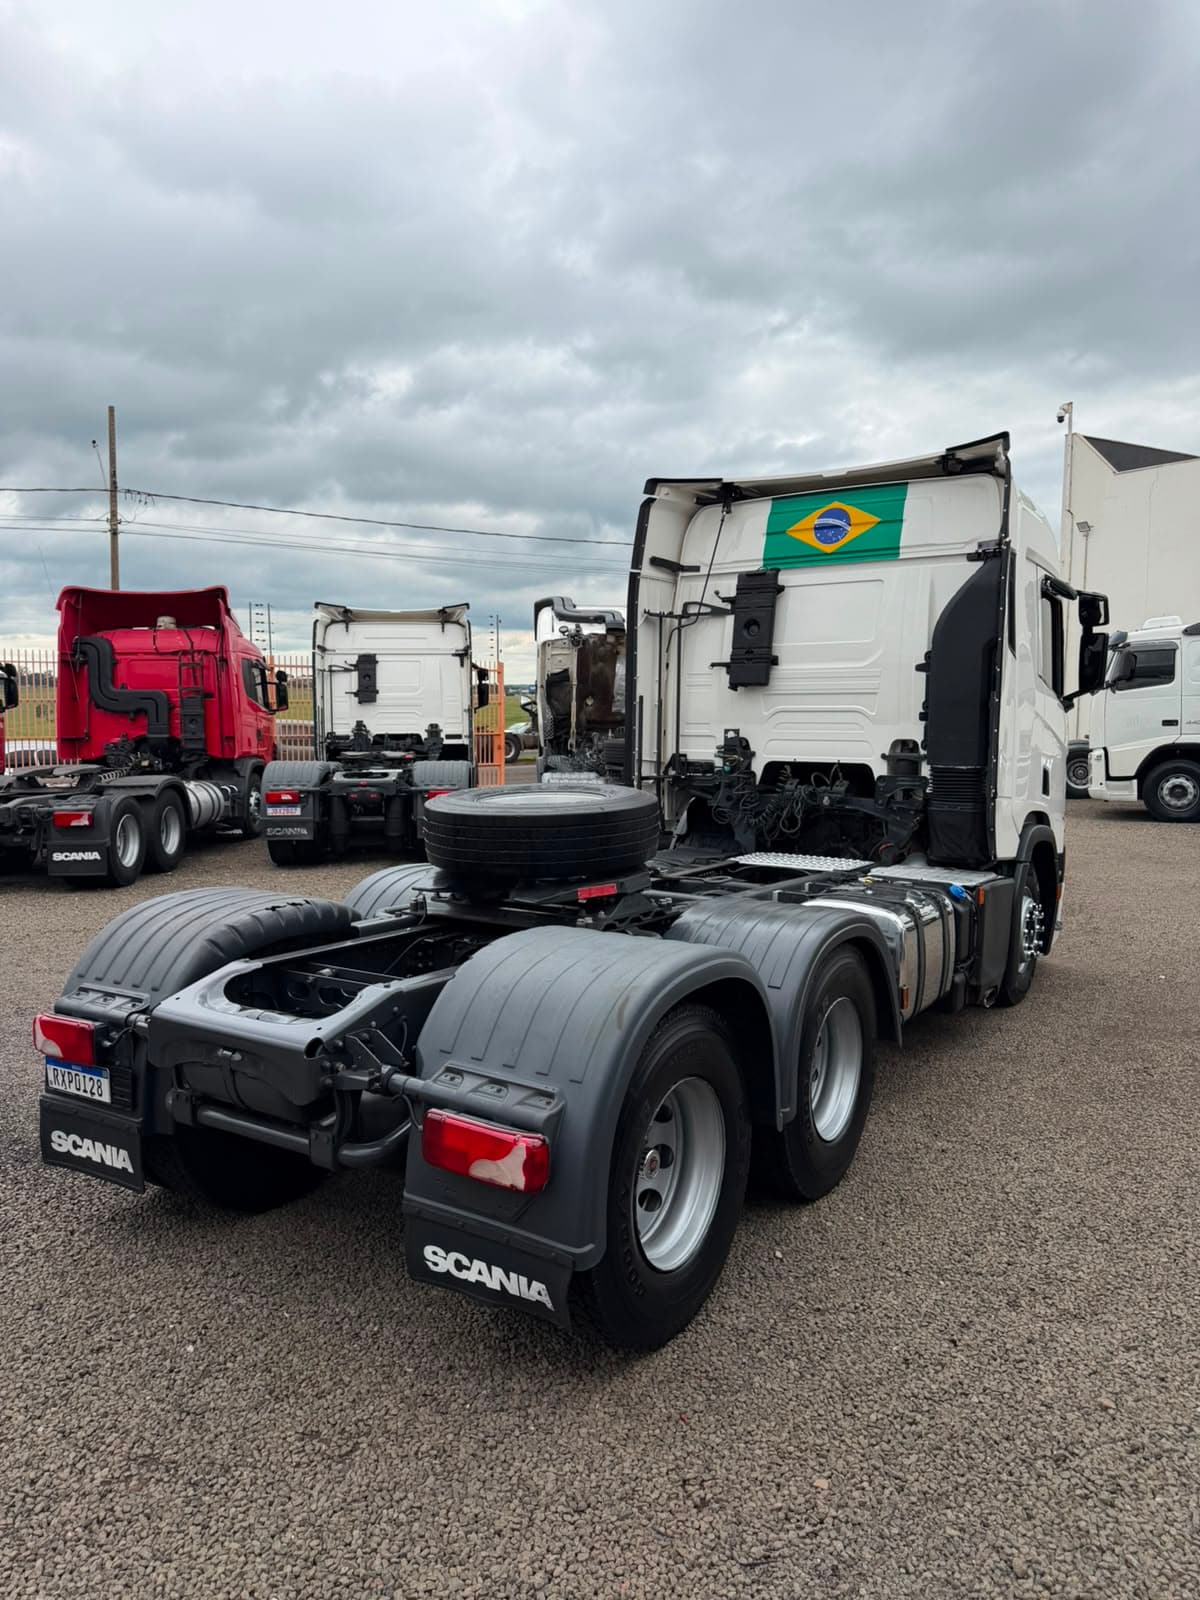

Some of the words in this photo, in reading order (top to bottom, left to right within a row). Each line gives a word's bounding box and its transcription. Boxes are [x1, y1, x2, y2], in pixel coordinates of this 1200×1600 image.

[52, 851, 101, 861] SCANIA
[50, 1130, 134, 1174] SCANIA
[423, 1245, 555, 1312] SCANIA
